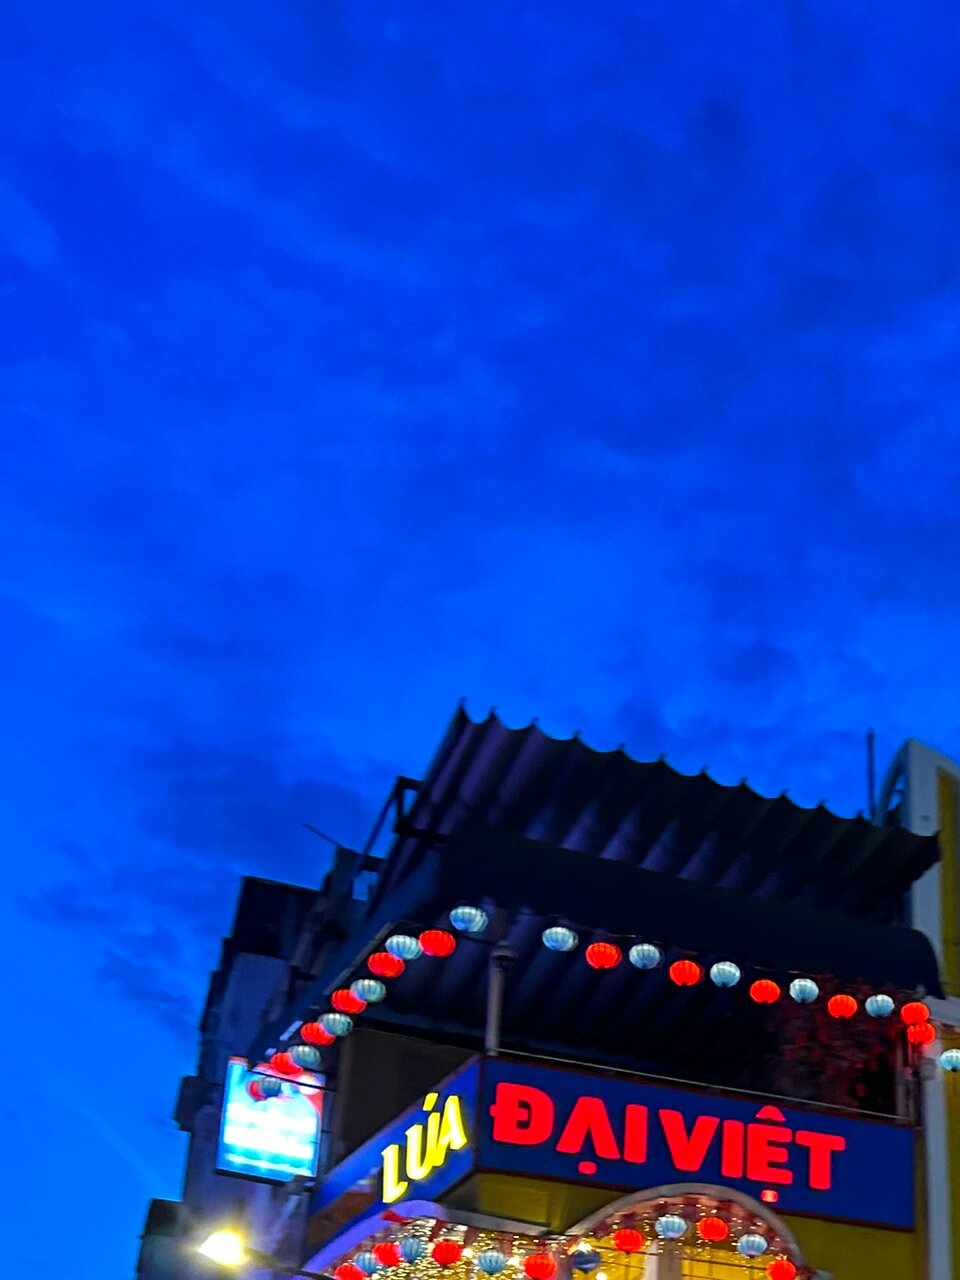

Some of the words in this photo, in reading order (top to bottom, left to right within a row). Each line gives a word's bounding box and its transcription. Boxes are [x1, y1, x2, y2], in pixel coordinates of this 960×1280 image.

[381, 1092, 468, 1204] LÚA
[490, 1081, 648, 1175] ĐẠI
[657, 1105, 847, 1204] VIỆT
